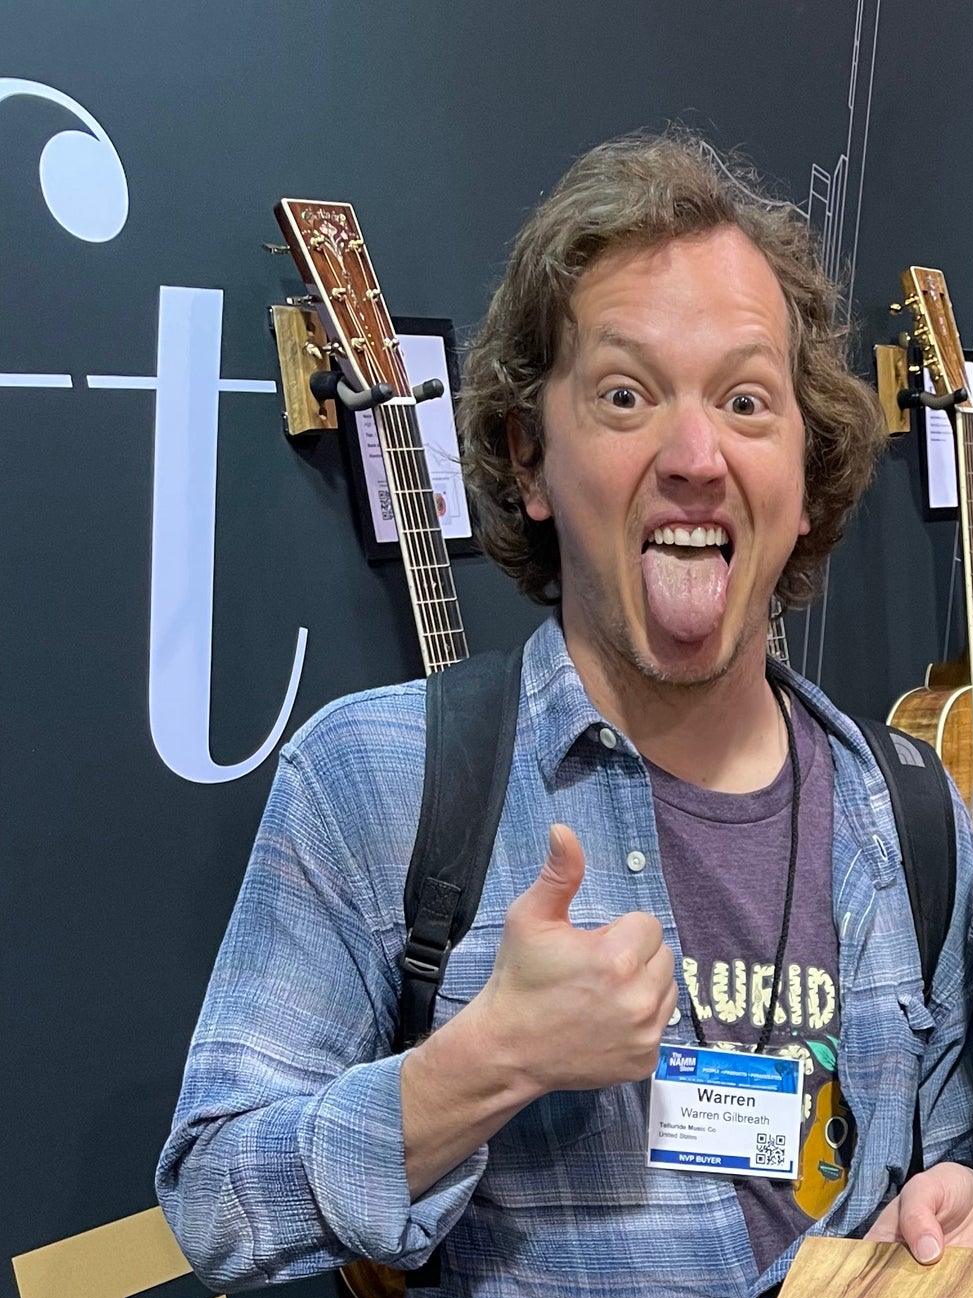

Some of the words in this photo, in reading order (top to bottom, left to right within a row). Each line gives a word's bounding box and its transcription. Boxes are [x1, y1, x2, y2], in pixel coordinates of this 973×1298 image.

[669, 1056, 697, 1067] NAMM
[698, 1088, 756, 1107] Warren
[681, 1107, 719, 1121] Warren
[723, 1111, 770, 1125] Gilbreath
[688, 1124, 706, 1132] Music
[696, 1156, 722, 1164] BUYER
